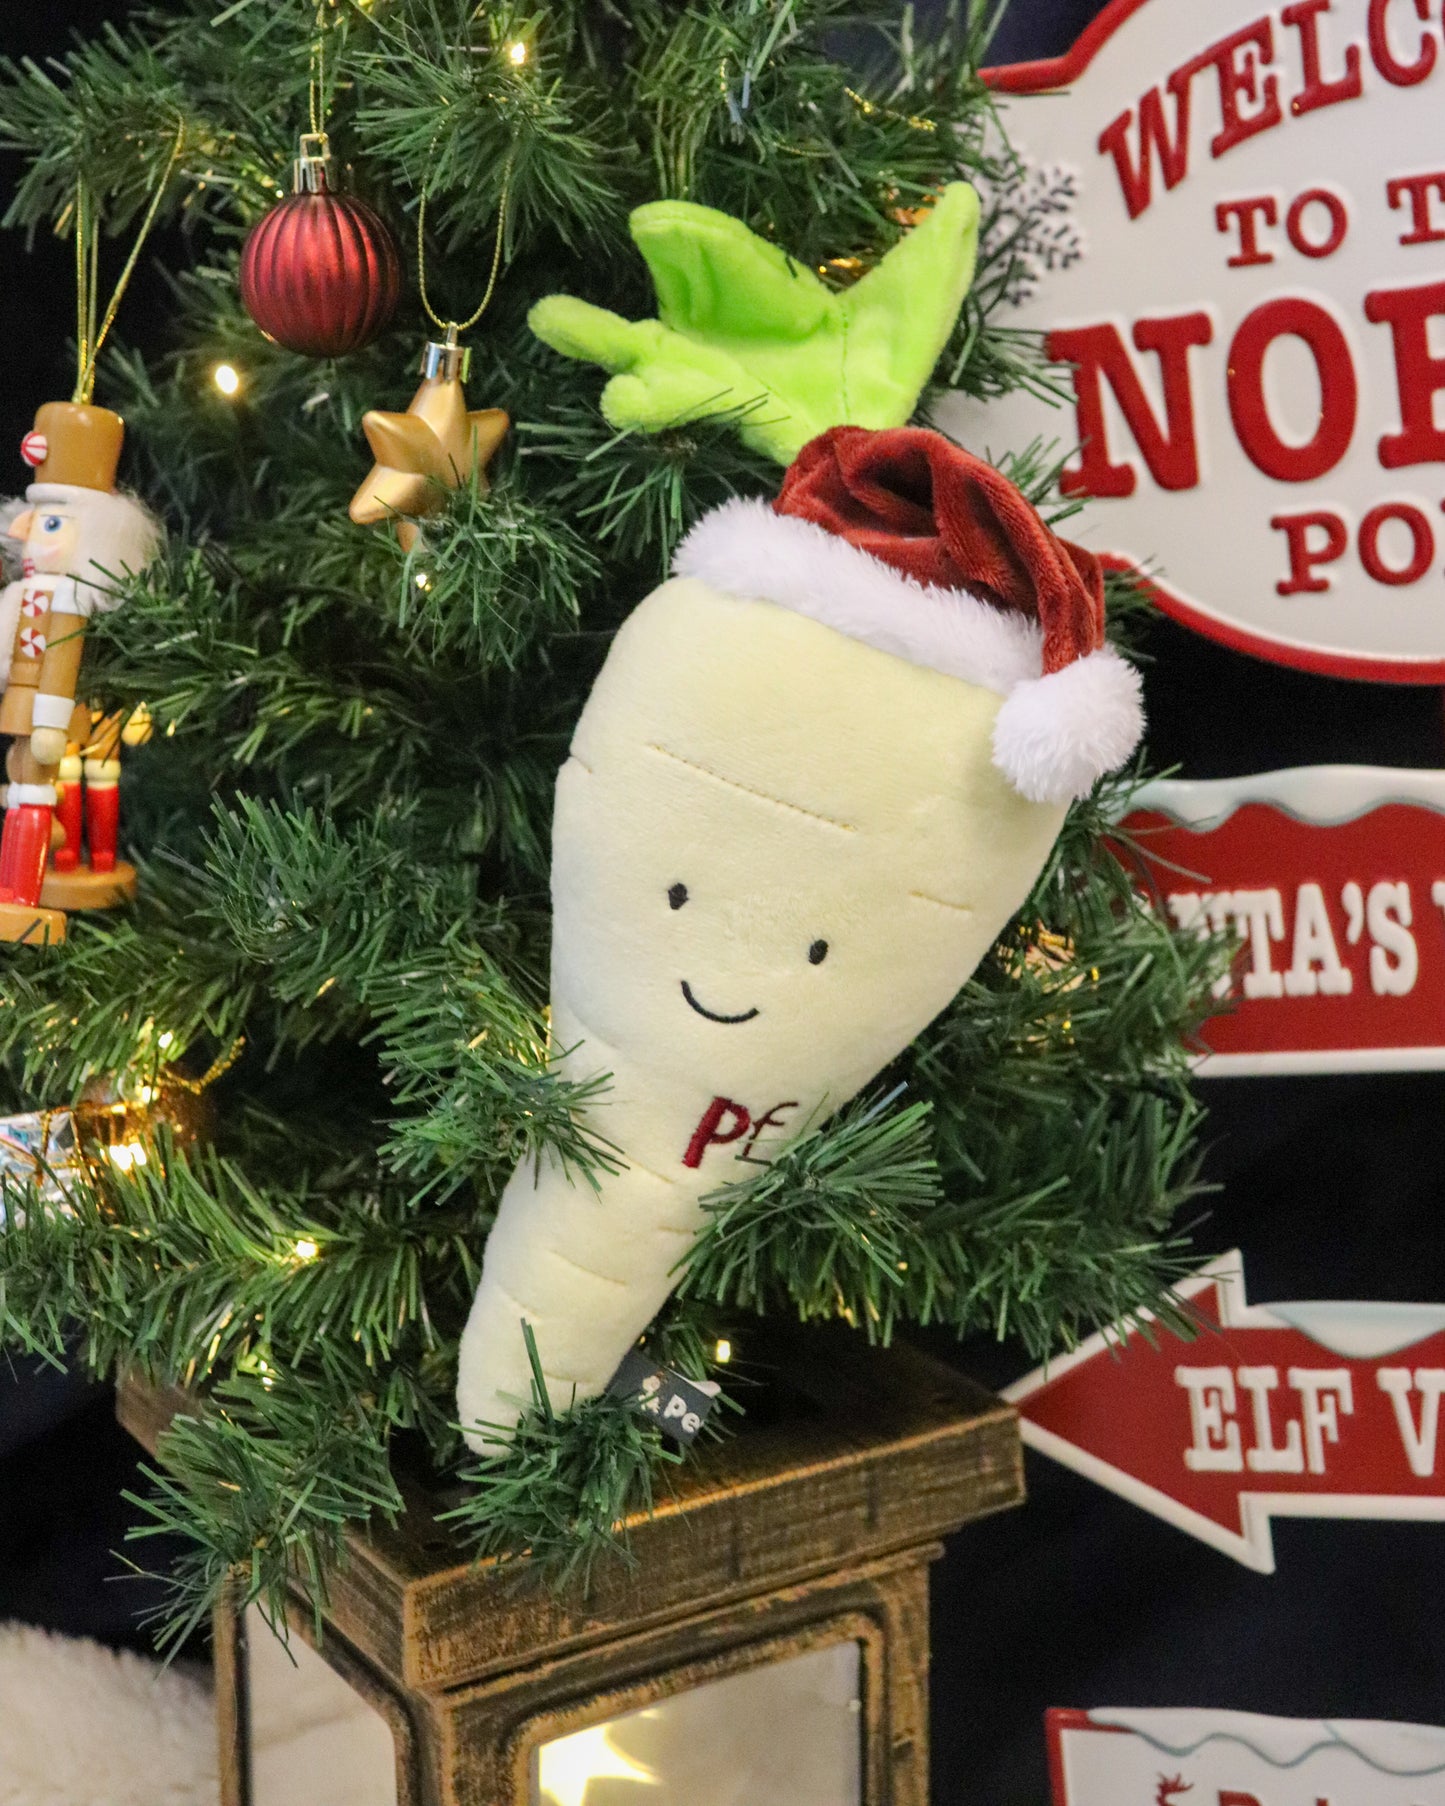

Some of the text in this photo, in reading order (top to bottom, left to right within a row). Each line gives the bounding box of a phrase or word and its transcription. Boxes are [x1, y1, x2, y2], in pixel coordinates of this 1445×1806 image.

[1097, 0, 1445, 221] WELC
[1216, 188, 1347, 268] TO
[1270, 502, 1445, 597] PO
[1174, 1365, 1355, 1475] ELF
